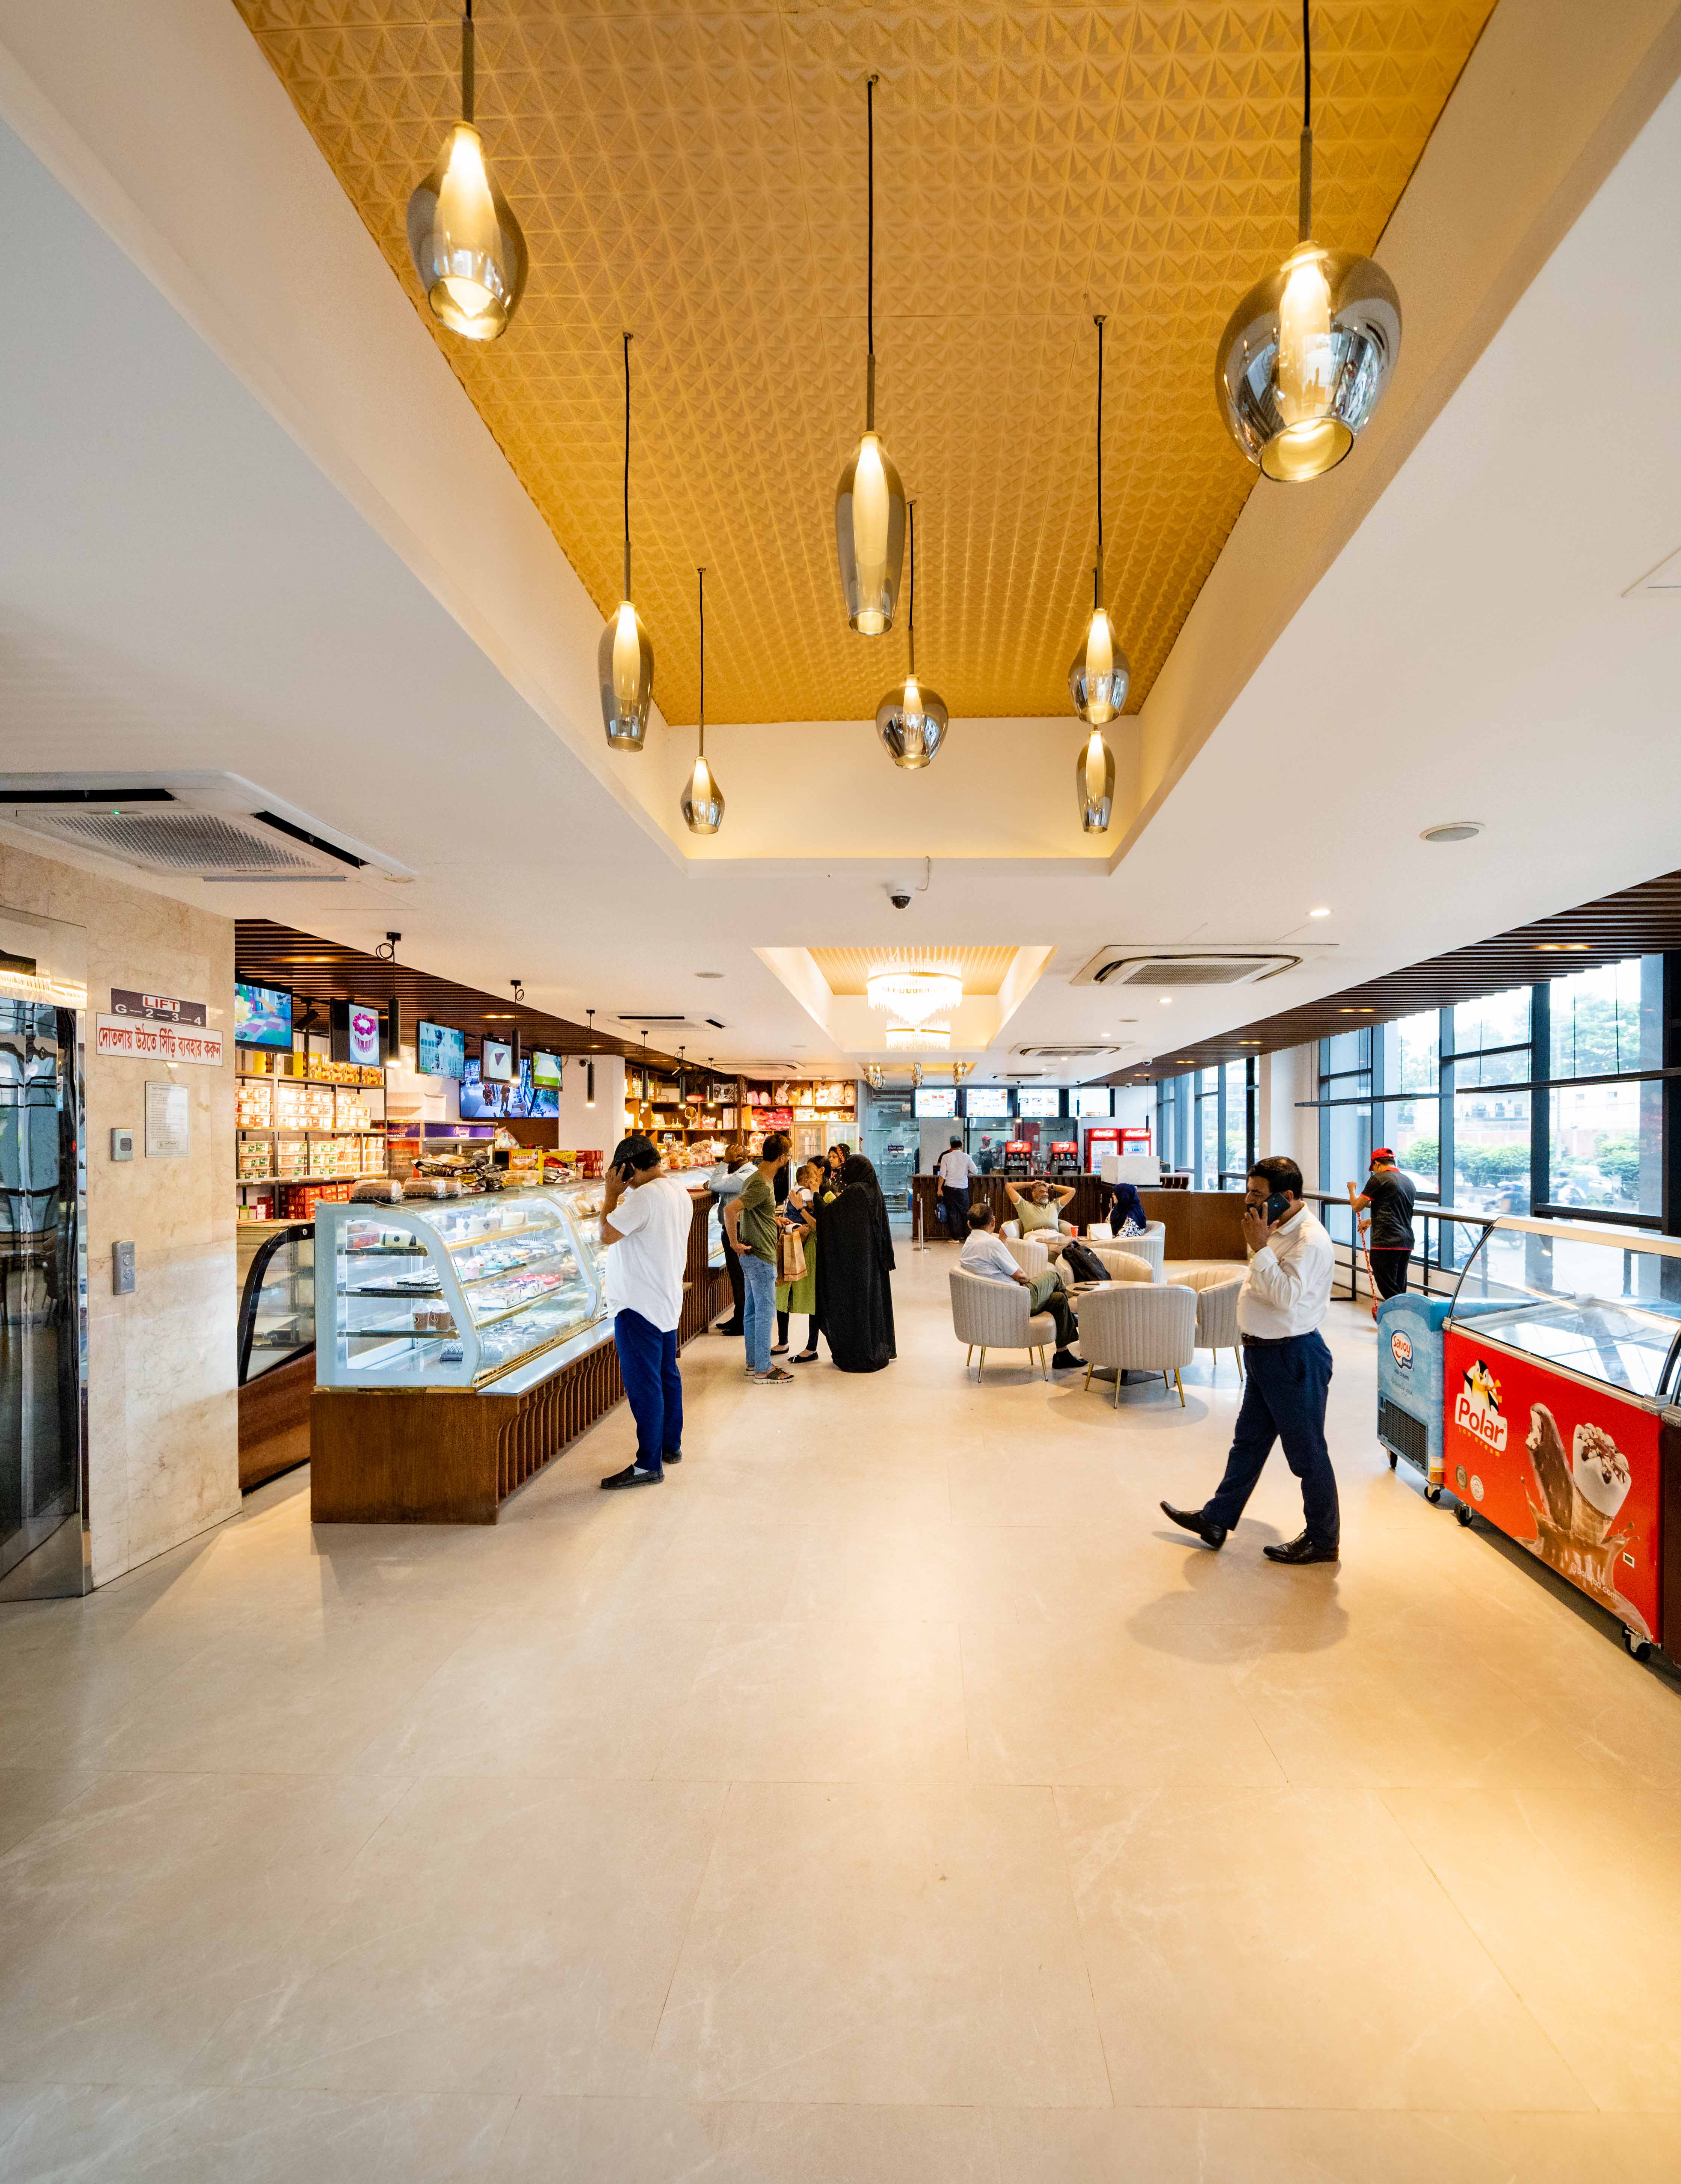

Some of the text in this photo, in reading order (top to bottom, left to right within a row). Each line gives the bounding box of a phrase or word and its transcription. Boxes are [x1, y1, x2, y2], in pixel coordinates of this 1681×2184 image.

[145, 997, 179, 1011] LIFT
[98, 1025, 133, 1050] দোতলায়
[134, 1023, 157, 1052] উঠতে
[178, 1037, 202, 1060] ব্যবহার
[203, 1040, 221, 1060] করুন
[1393, 1336, 1411, 1358] Savoy
[1400, 1371, 1409, 1381] cream
[1458, 1397, 1504, 1443] Polar
[1459, 1426, 1500, 1457] ice cream
